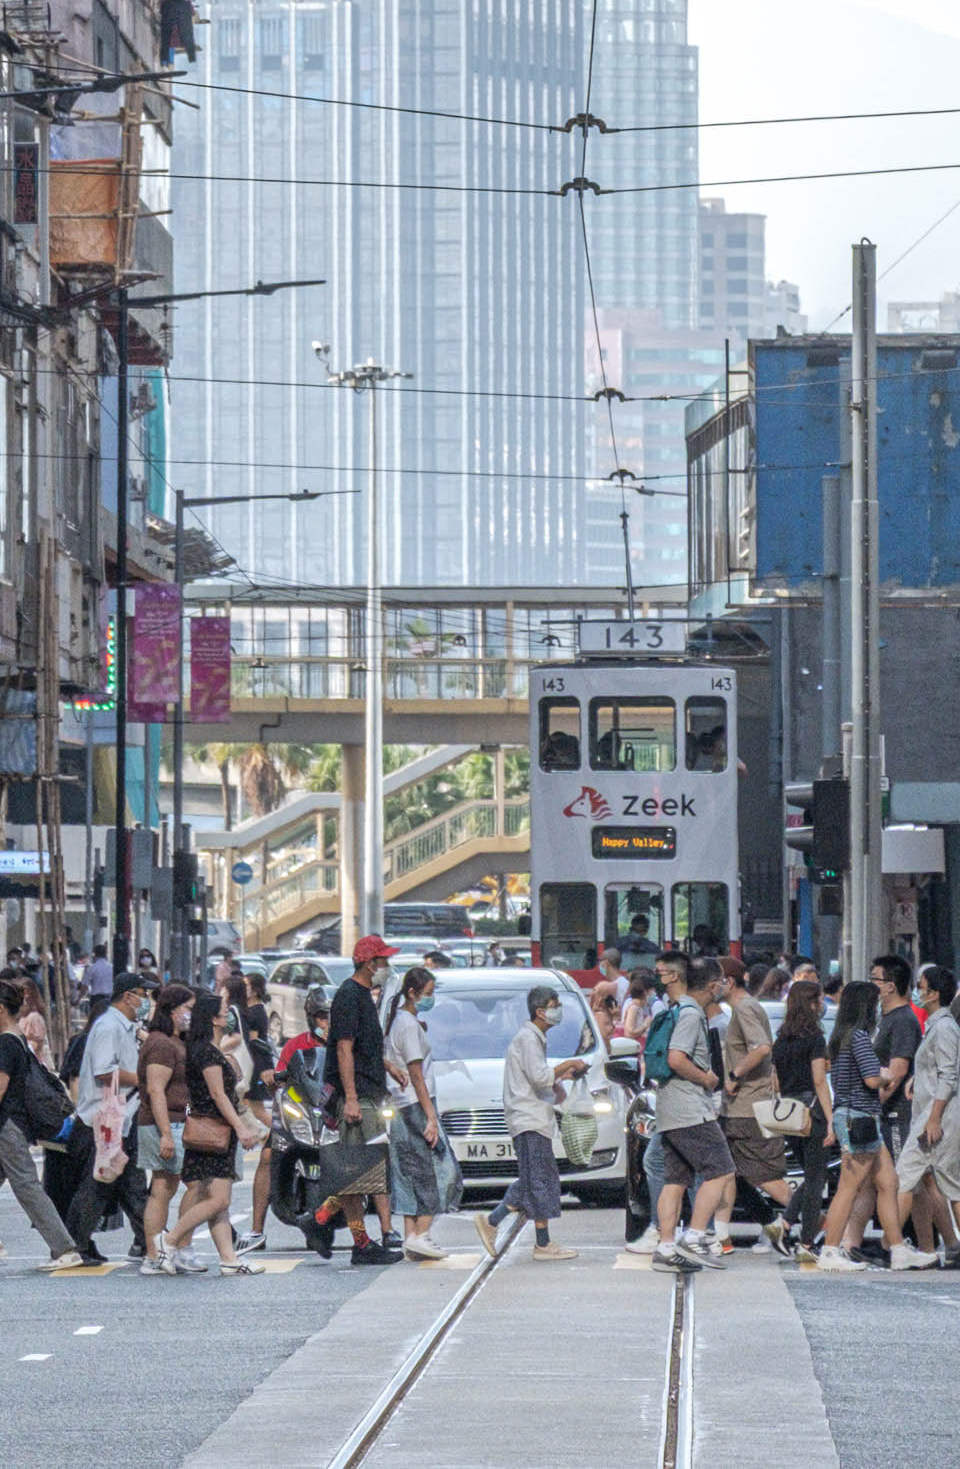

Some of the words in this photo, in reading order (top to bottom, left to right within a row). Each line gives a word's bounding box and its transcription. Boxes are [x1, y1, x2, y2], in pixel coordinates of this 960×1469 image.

[603, 626, 664, 649] 143
[542, 679, 565, 692] 143
[711, 678, 732, 691] 143
[602, 836, 628, 848] Happy
[632, 836, 665, 848] Valley
[467, 1144, 488, 1158] MA
